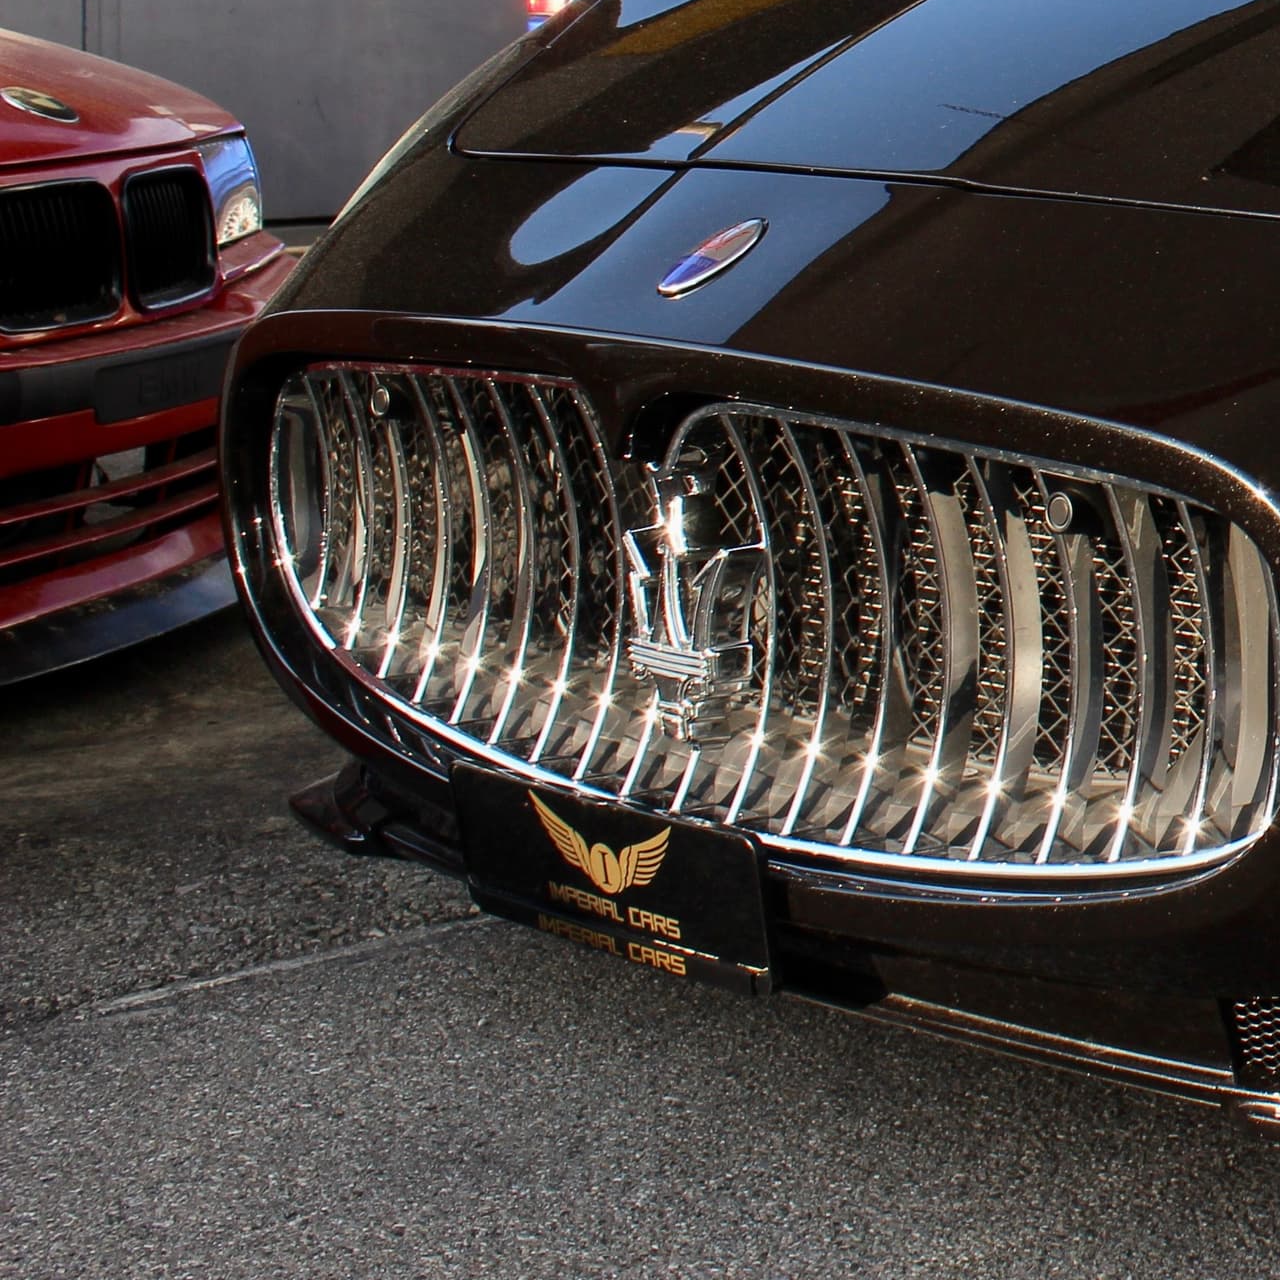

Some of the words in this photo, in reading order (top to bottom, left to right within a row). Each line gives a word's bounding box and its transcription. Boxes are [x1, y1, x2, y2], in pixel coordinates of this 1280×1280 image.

[548, 880, 625, 924] IMPERIAL
[627, 906, 682, 940] CARS
[537, 912, 626, 957] IMPERIAL
[627, 941, 687, 976] CARS
